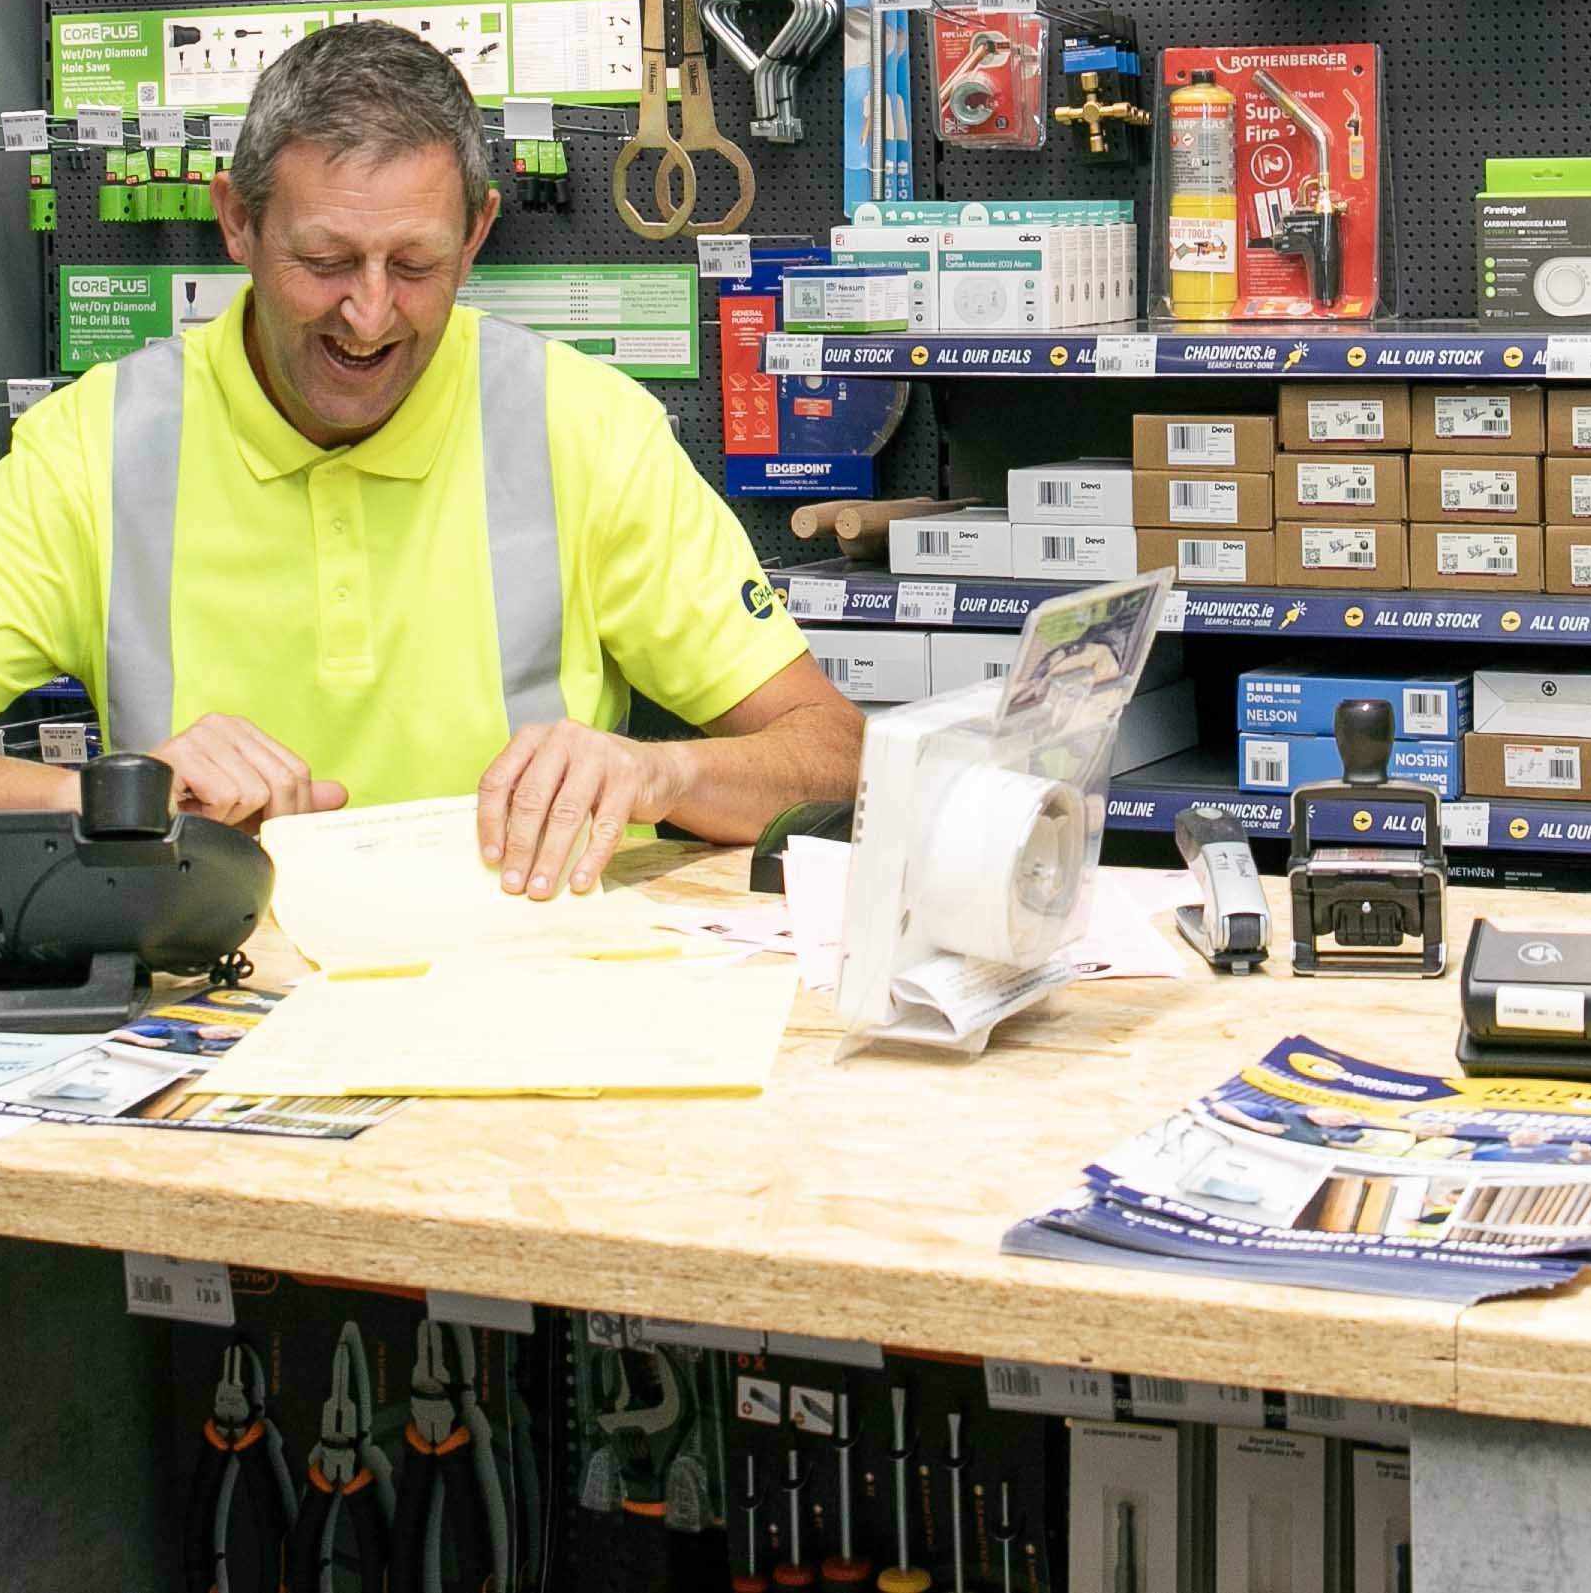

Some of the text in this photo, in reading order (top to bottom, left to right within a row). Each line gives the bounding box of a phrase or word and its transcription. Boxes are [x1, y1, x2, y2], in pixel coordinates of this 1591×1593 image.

[62, 46, 148, 60] Wet/Dry Diamond
[1231, 53, 1347, 68] ROTHENBERGER
[62, 62, 110, 73] Hole Saws
[838, 284, 865, 292] Nexum
[70, 302, 156, 313] Wet/Dry Diamond
[70, 315, 130, 326] Tile Drill Bits
[825, 349, 850, 363] OUR
[854, 348, 894, 363] STOCK
[937, 348, 1031, 364] ALL OUR DEALS
[1185, 345, 1277, 361] CHADWICKS.ie
[1377, 349, 1483, 365] ALL OUR STOCK
[1211, 425, 1233, 434] Deva
[766, 464, 832, 474] EDGEPOINT
[1081, 482, 1101, 491] Deva
[959, 531, 979, 540] Deva
[1531, 616, 1553, 631] ALL
[1556, 616, 1587, 631] OUR
[1246, 692, 1274, 704] Deva
[1246, 710, 1297, 723] NELSON
[1395, 753, 1448, 767] NELSON
[1448, 866, 1494, 878] METHVEN
